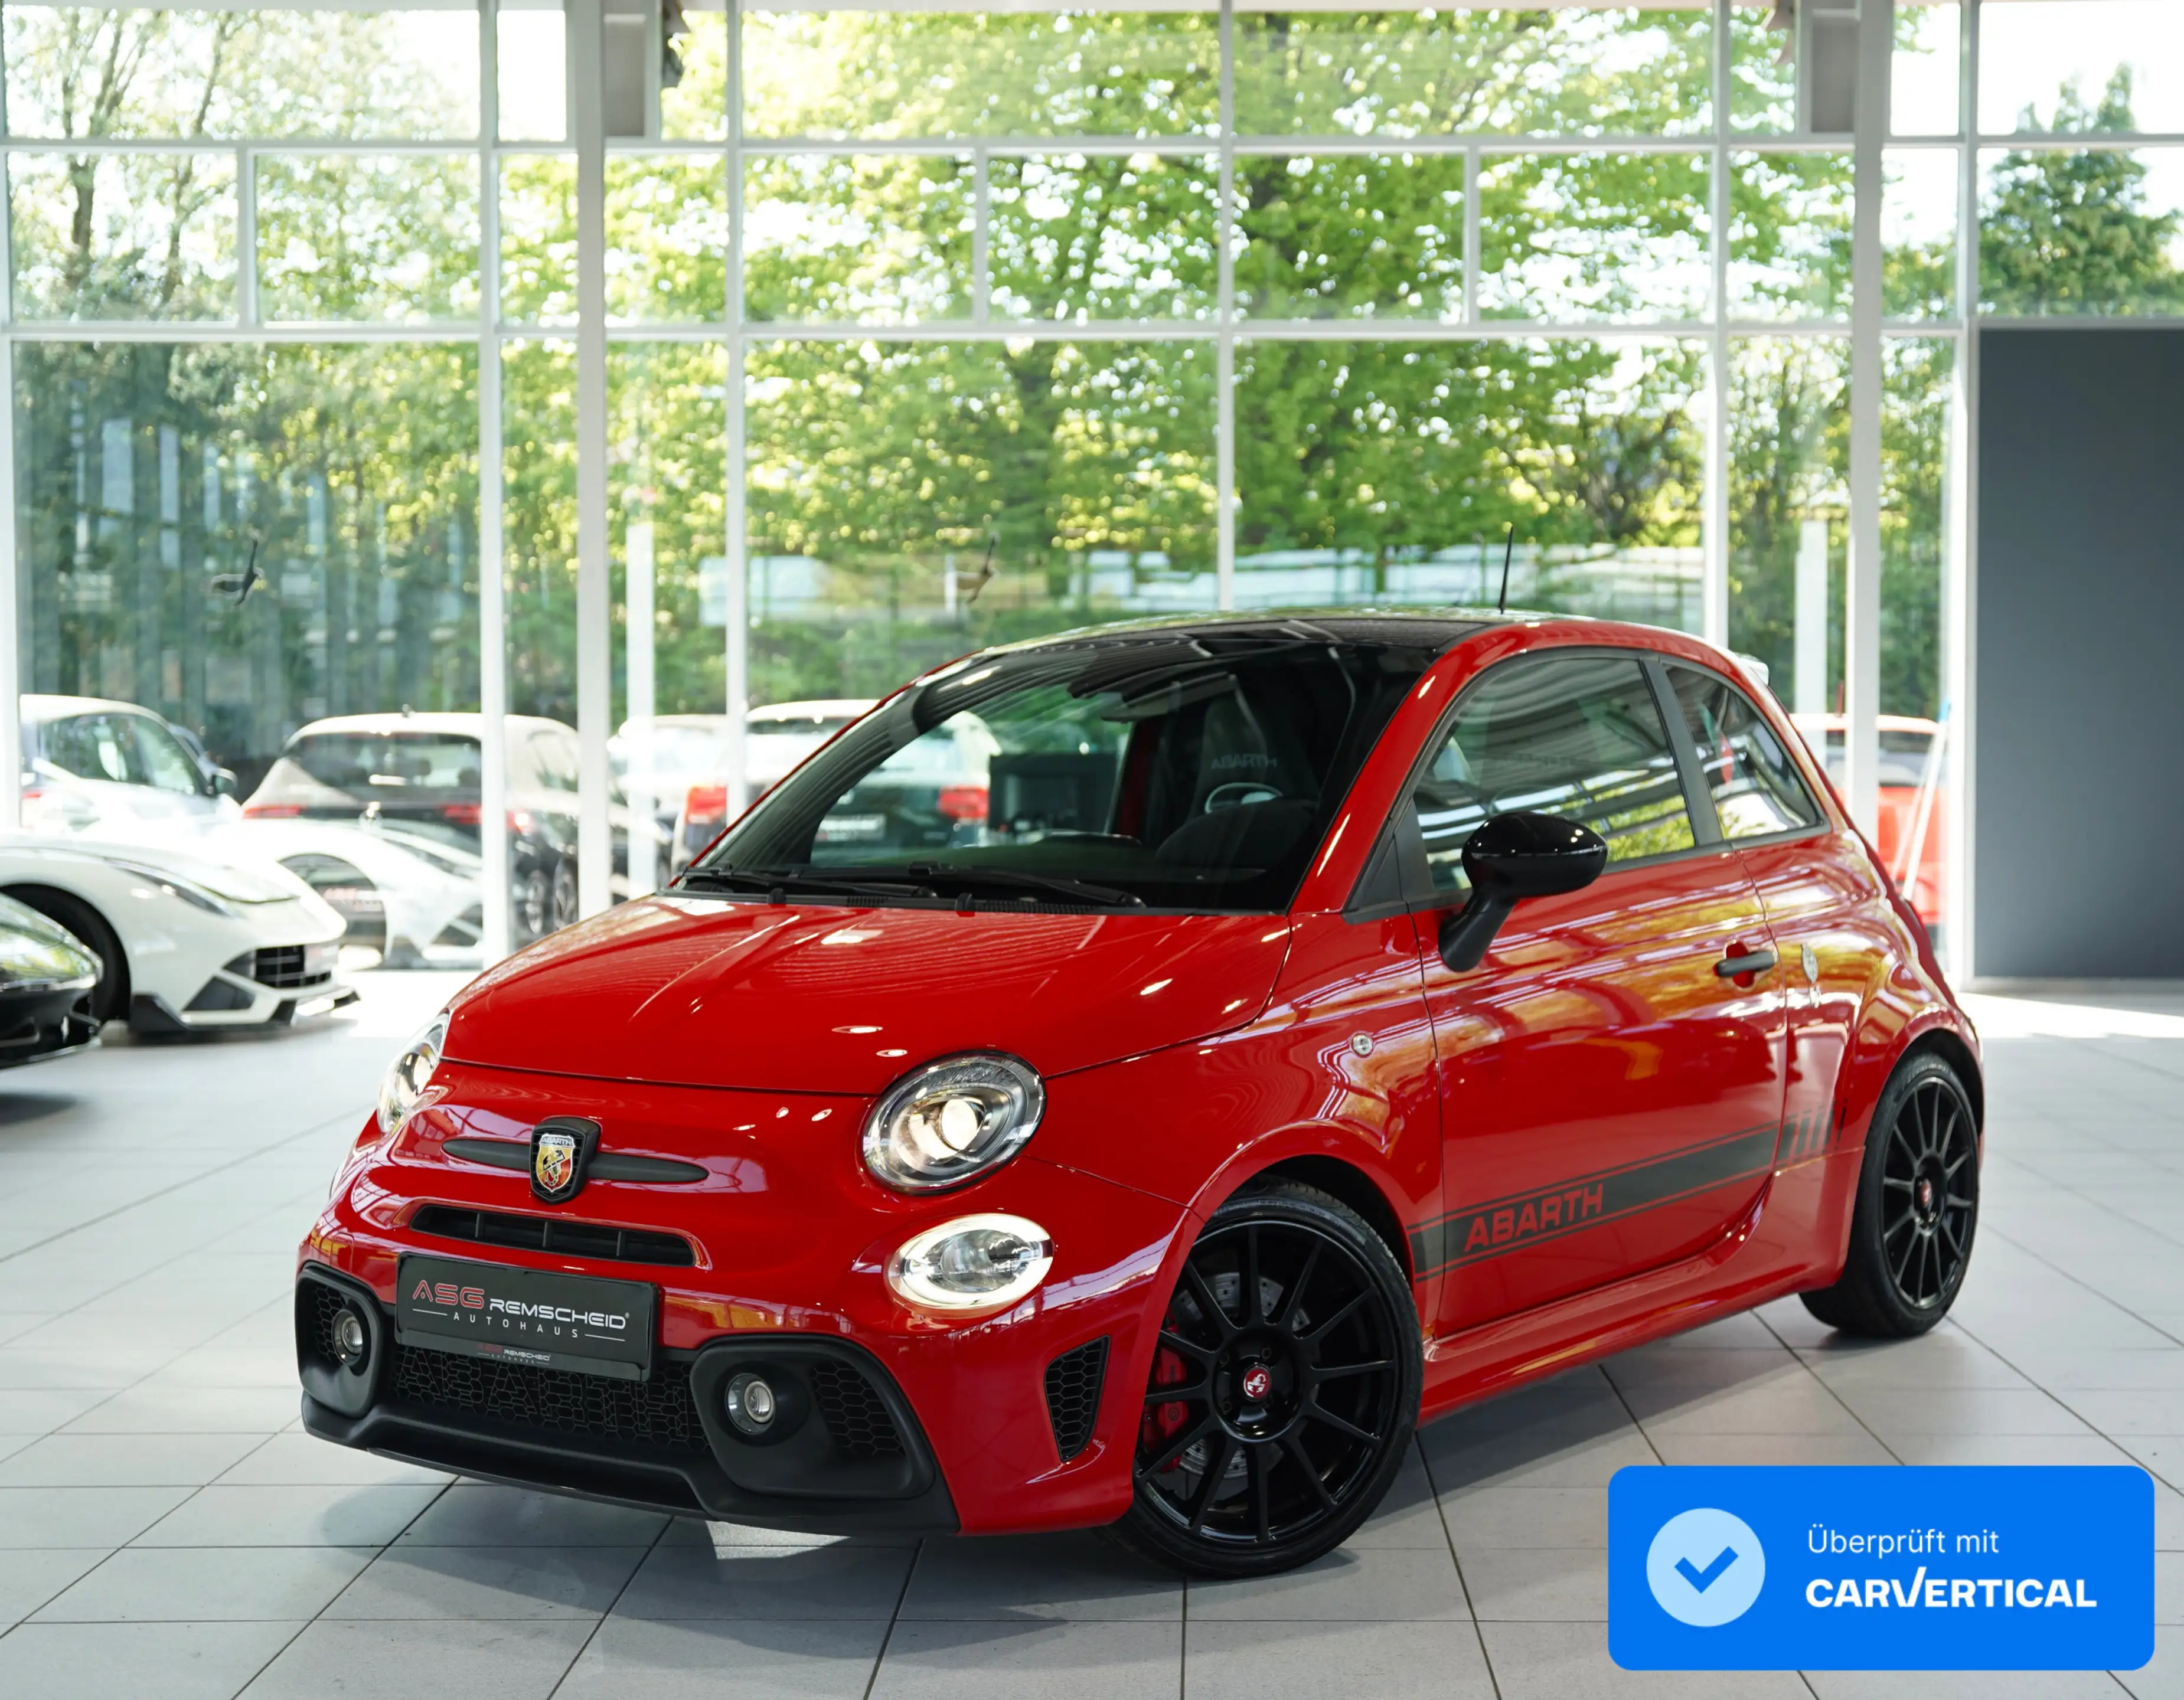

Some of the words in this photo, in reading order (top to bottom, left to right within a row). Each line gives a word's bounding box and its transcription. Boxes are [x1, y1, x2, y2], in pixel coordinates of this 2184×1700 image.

[1211, 753, 1278, 769] ABARTH
[541, 1137, 572, 1145] ABARTH
[1464, 1184, 1604, 1253] ABARTH
[412, 1279, 485, 1310] ASG
[453, 1312, 579, 1338] AUTOHAUS
